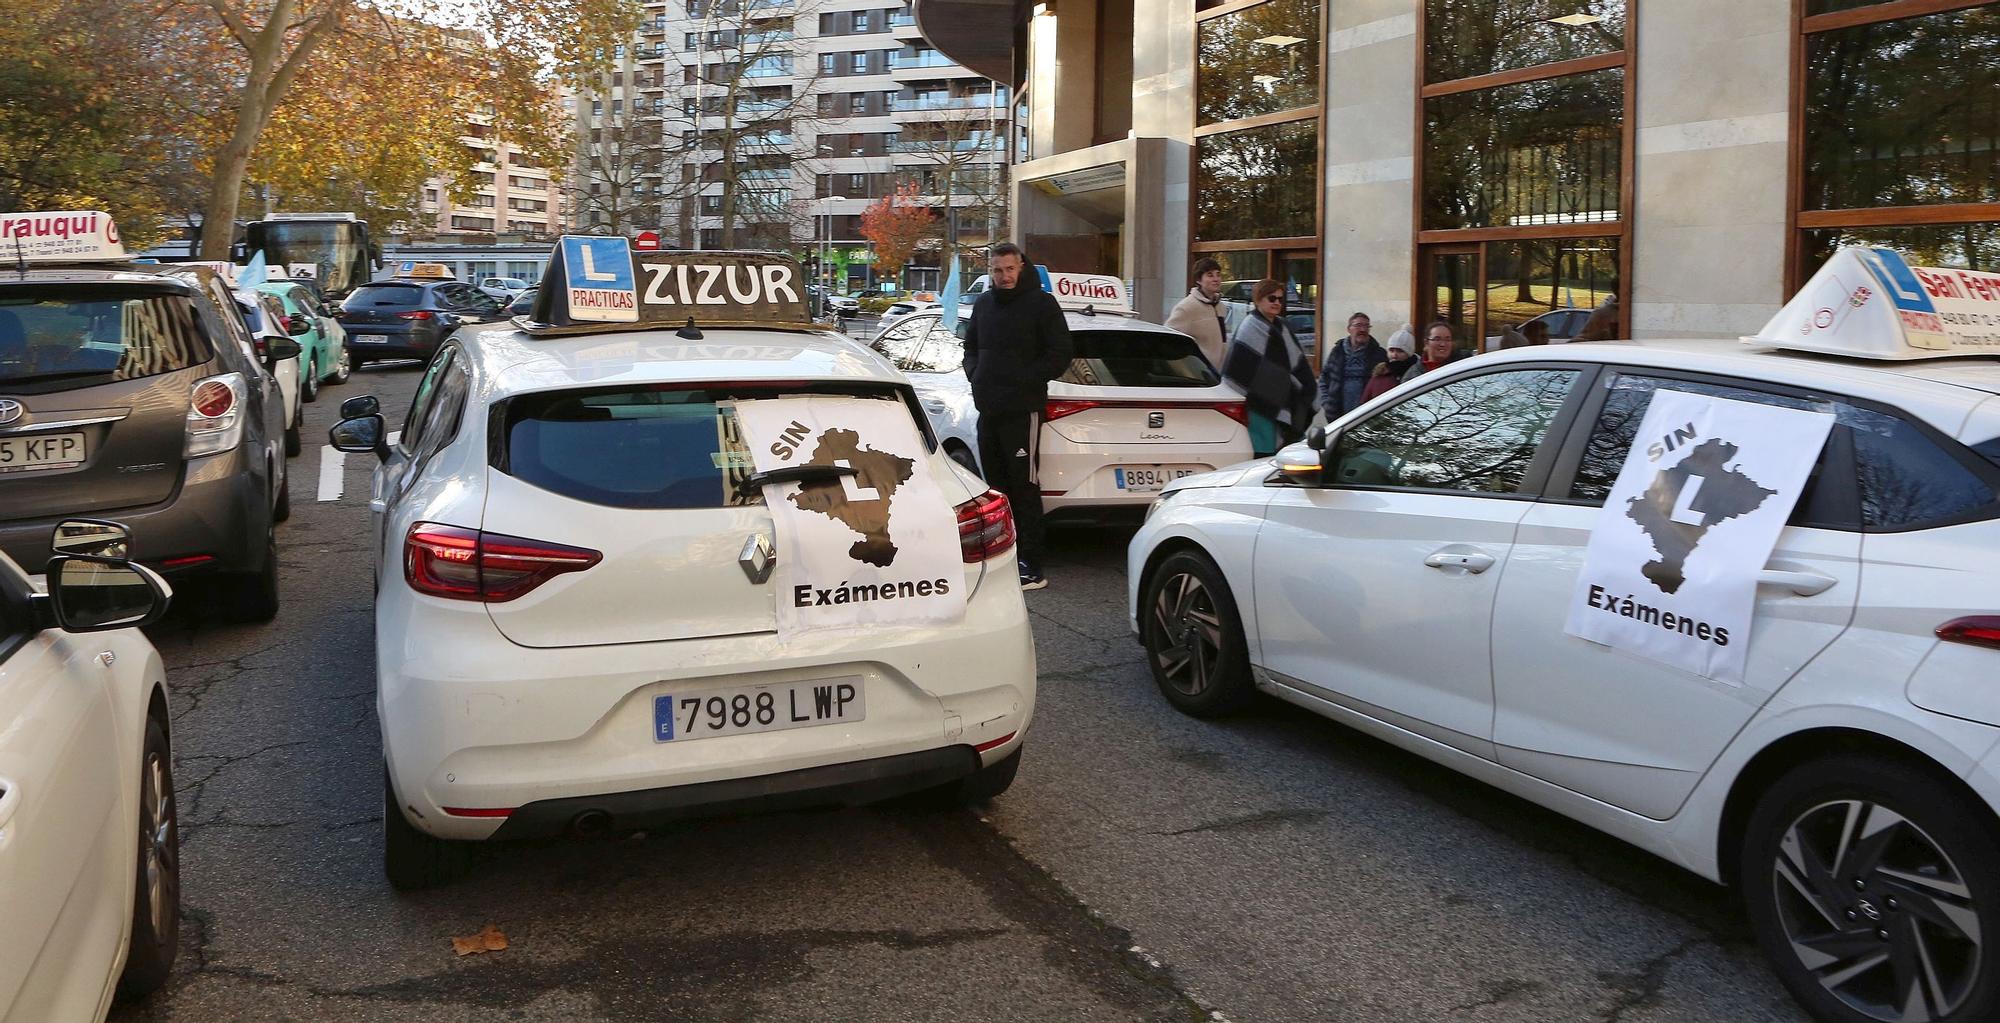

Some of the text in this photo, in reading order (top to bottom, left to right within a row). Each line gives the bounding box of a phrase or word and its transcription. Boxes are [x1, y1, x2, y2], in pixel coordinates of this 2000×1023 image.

[581, 244, 617, 281] L
[572, 289, 634, 309] PRACTICAS
[641, 263, 799, 305] ZIZUR
[1058, 277, 1117, 298] Orvina
[1912, 268, 1964, 298] San
[26, 438, 75, 461] KFP
[770, 420, 812, 461] SIN
[1647, 421, 1698, 462] SIN
[1126, 470, 1164, 486] 8894
[1670, 474, 1707, 527] L
[794, 578, 950, 608] Exámenes
[1587, 584, 1730, 647] Exámenes
[661, 684, 856, 734] E 7988 LWP
